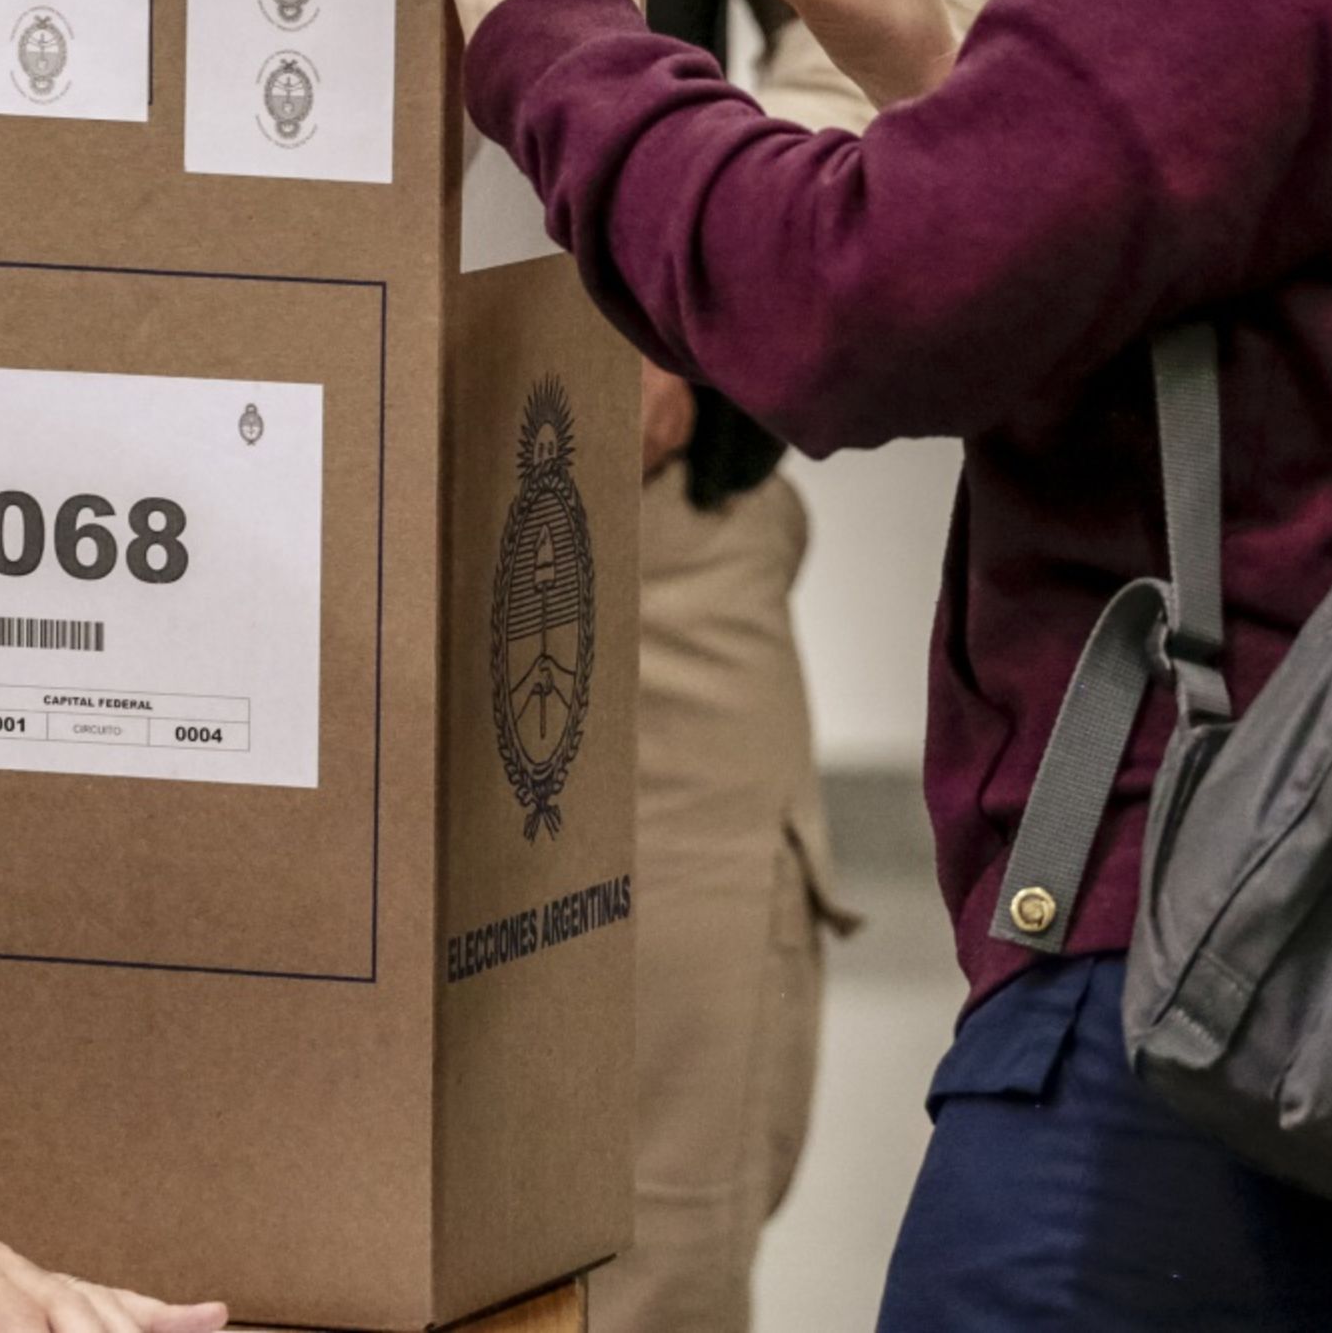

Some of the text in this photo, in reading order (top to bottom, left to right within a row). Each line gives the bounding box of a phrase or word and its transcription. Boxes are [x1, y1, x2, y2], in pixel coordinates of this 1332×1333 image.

[43, 694, 153, 712] CAPITAL FEDERAL
[175, 725, 223, 744] 0004
[448, 874, 632, 984] ELECCIONES ARGENTINAS
